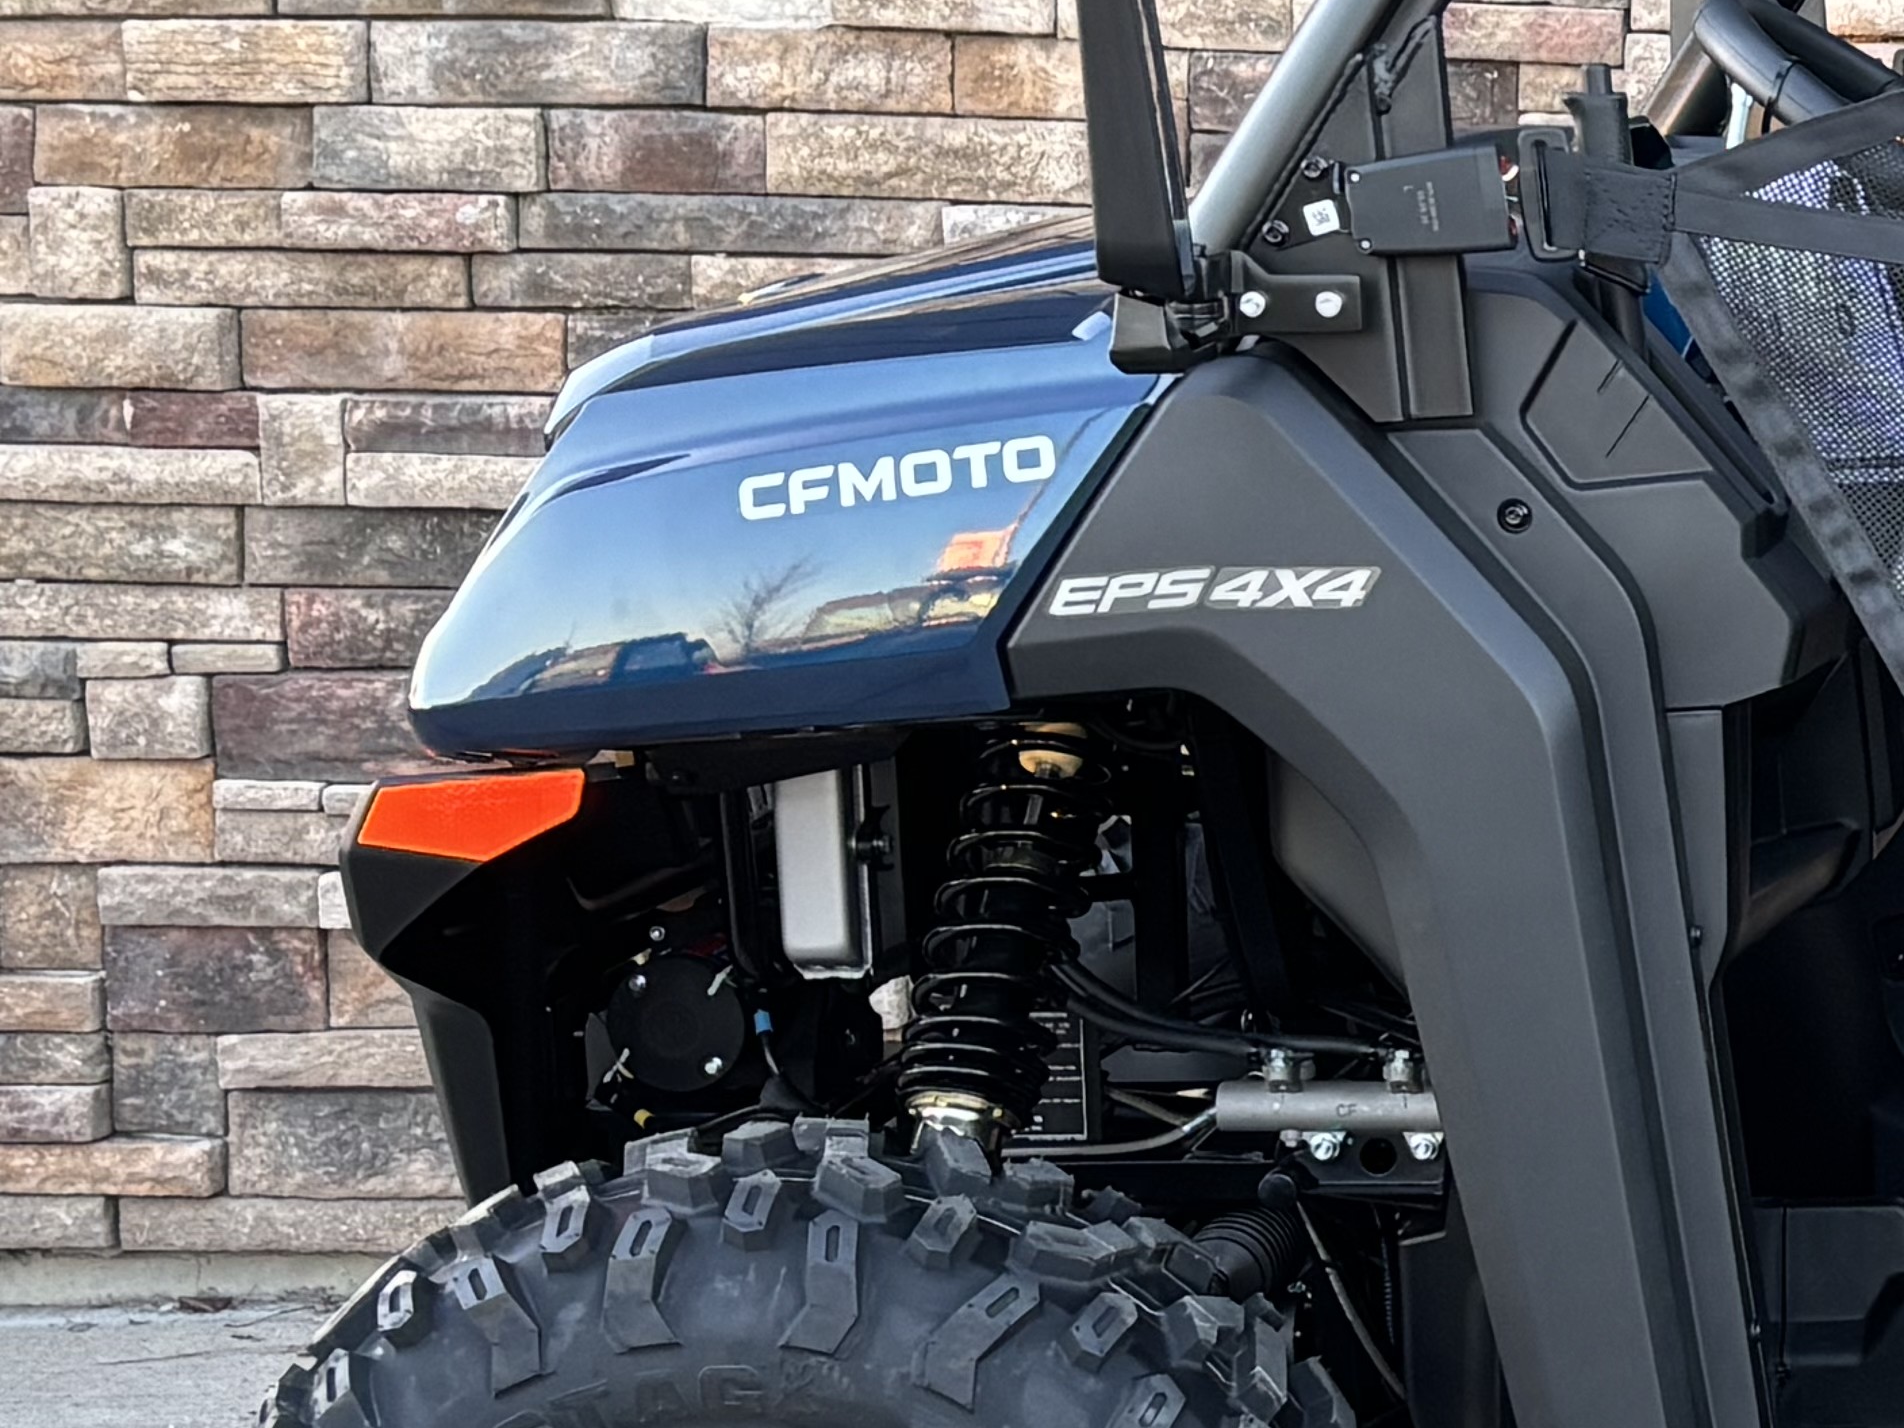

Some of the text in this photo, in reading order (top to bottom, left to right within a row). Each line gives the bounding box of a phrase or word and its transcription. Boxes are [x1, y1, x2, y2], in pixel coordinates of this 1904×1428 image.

[738, 435, 1056, 520] CFMOTO
[1049, 569, 1371, 615] EPS 4X4
